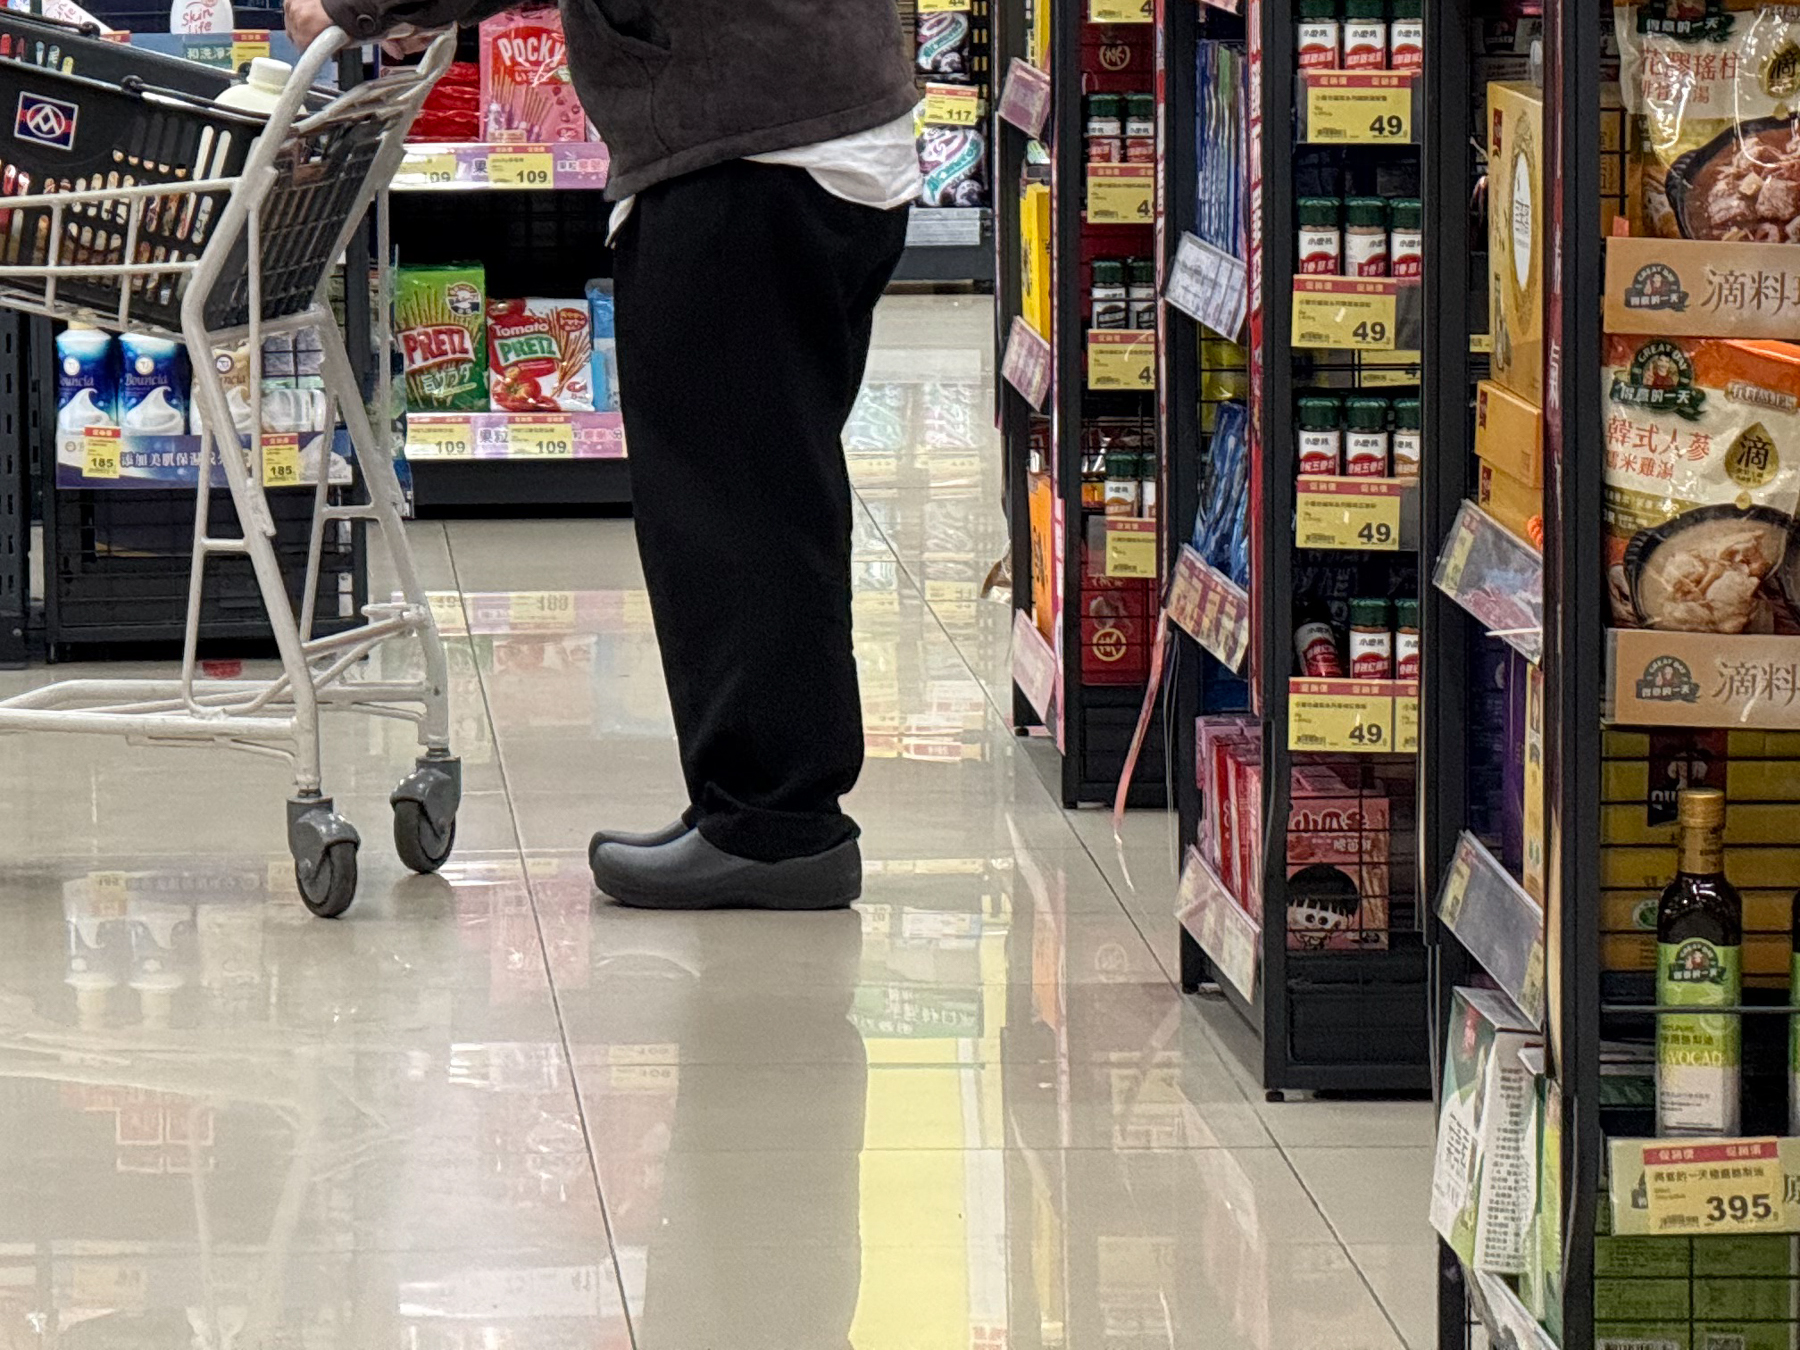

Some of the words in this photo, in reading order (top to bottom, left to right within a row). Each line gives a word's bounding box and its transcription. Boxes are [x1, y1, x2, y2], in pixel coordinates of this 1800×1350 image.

[182, 7, 213, 28] Skin
[947, 108, 972, 122] 117
[1369, 114, 1403, 135] 49
[517, 171, 549, 184] 109
[493, 322, 550, 337] Tomato
[1352, 321, 1386, 342] 49
[403, 328, 470, 366] PRETZ
[497, 335, 557, 363] PRETZ
[60, 377, 95, 387] ouncia
[125, 374, 168, 386] Bouncia
[435, 440, 466, 455] 109
[535, 439, 567, 455] 109
[90, 458, 114, 469] 185
[271, 466, 294, 477] 185
[1357, 523, 1391, 542] 49
[1349, 723, 1383, 744] 49
[1706, 1193, 1773, 1222] 395
